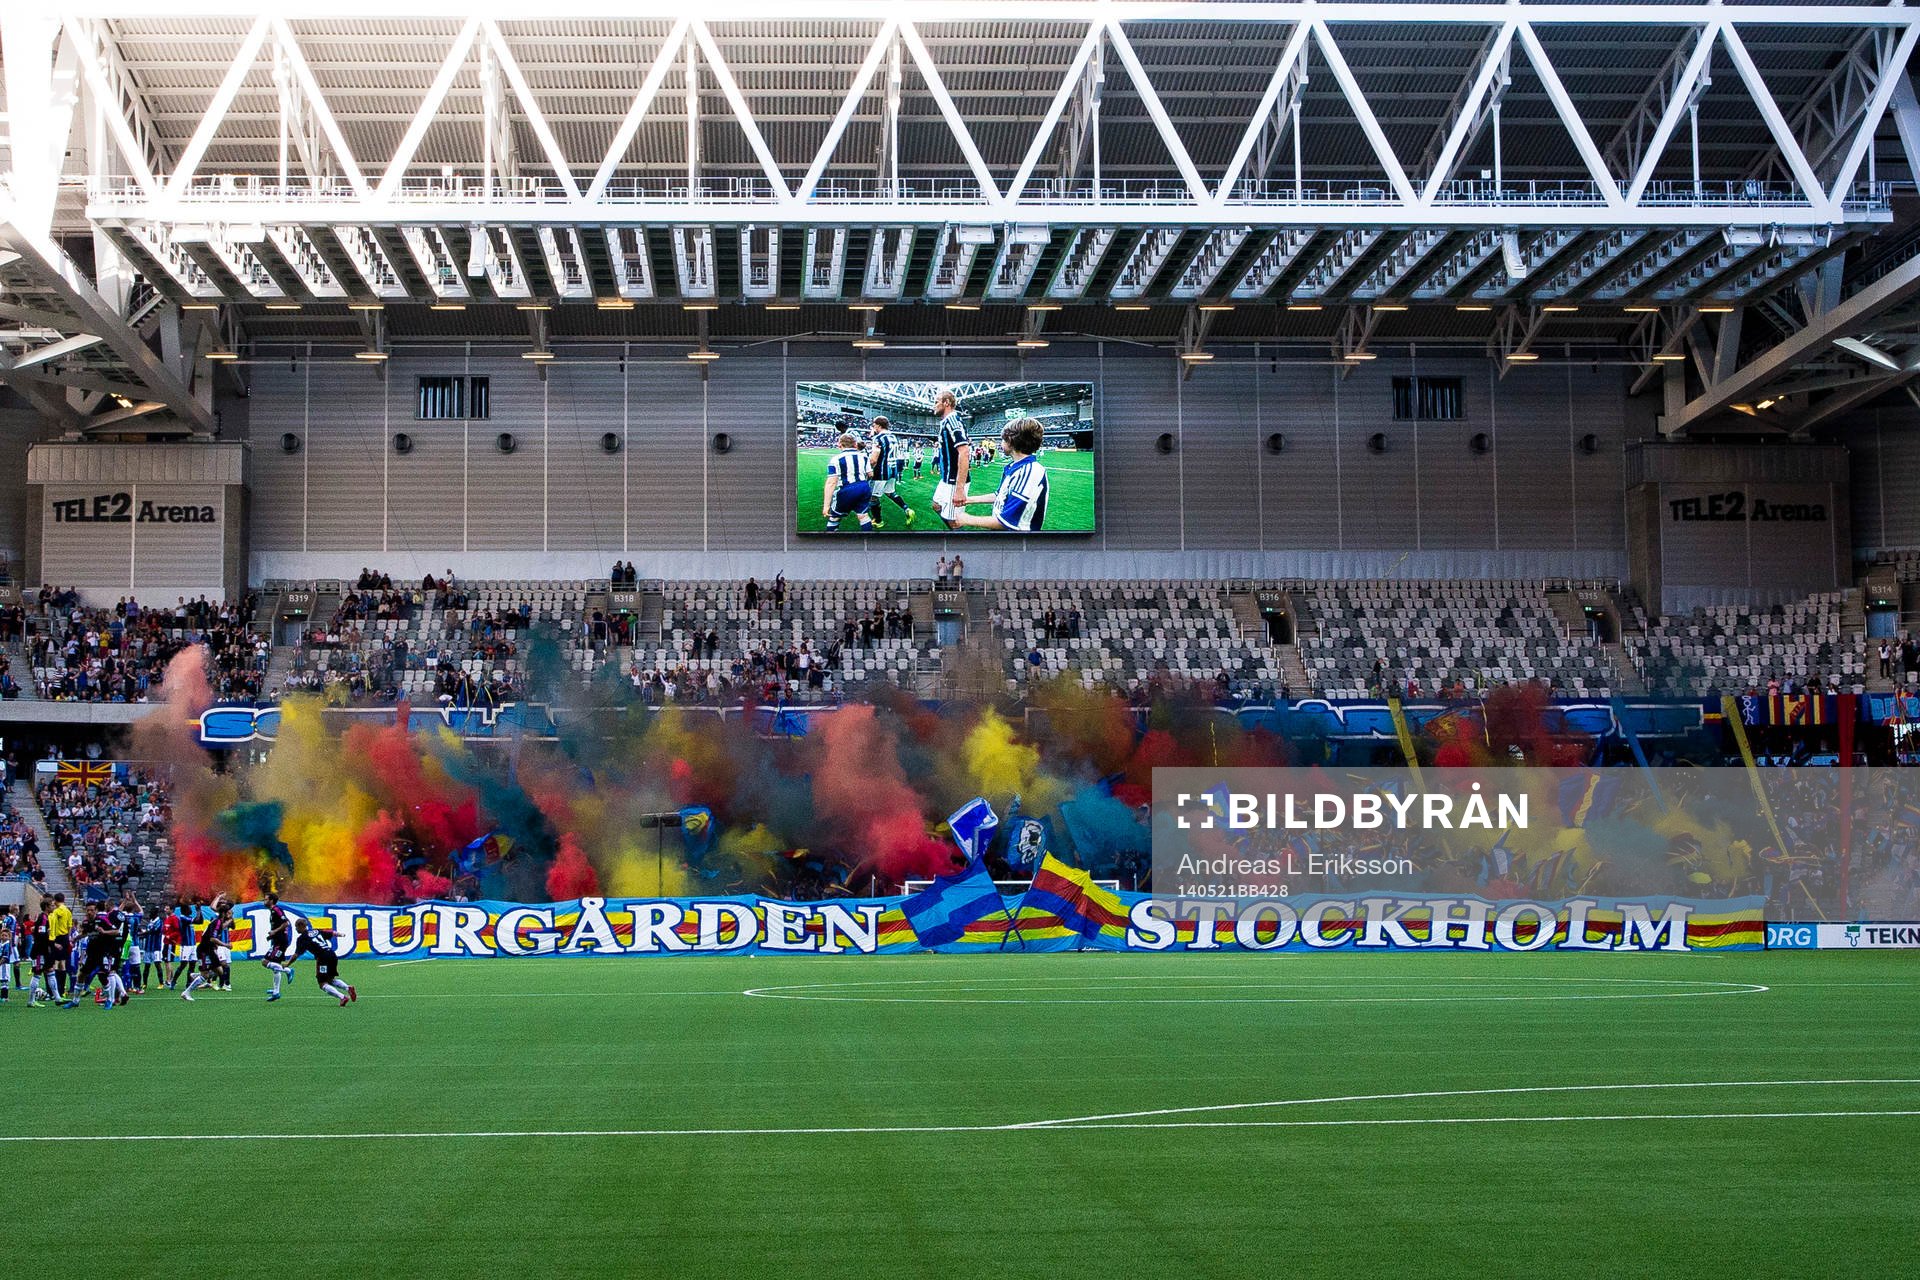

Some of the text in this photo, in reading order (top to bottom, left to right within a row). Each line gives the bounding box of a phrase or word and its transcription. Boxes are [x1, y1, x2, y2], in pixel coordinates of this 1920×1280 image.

[53, 492, 216, 523] TELE2 Arena
[1669, 491, 1828, 521] TELE2 Arena
[289, 594, 309, 602] B319
[614, 594, 634, 602] B318
[938, 593, 958, 602] B317
[1260, 593, 1280, 601] B316
[246, 897, 1693, 957] DJURGÅRDEN STOCKHOLM
